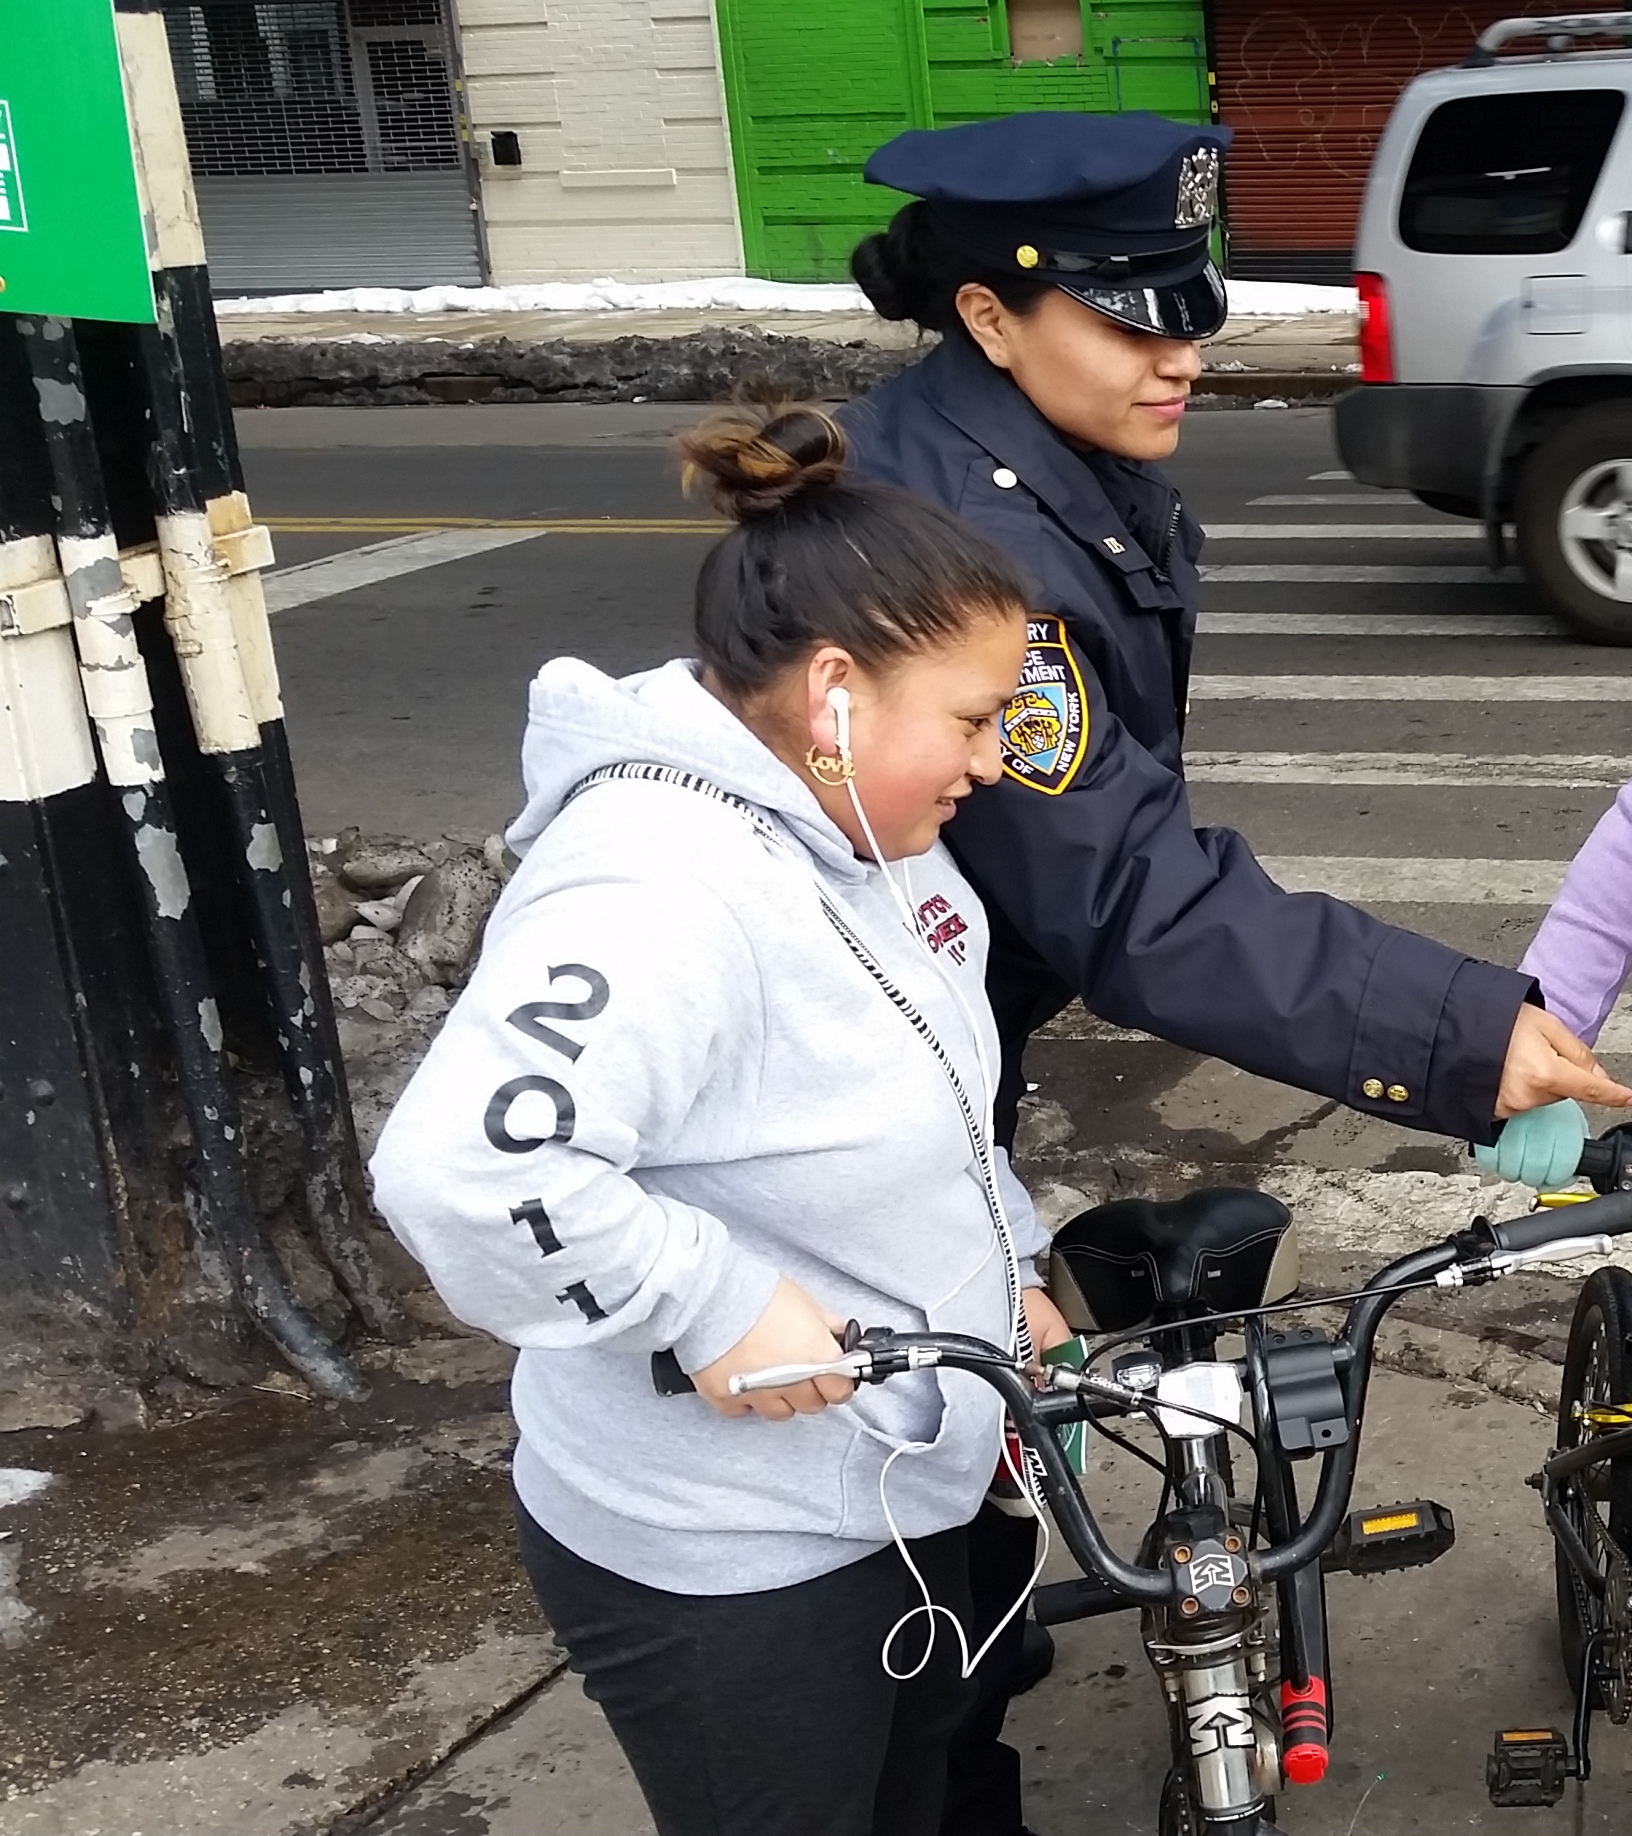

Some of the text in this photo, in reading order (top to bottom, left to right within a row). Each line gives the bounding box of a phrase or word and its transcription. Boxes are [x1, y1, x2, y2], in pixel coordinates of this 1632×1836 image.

[1012, 691, 1081, 775] OF NEW YORK
[483, 962, 611, 1326] 2011
